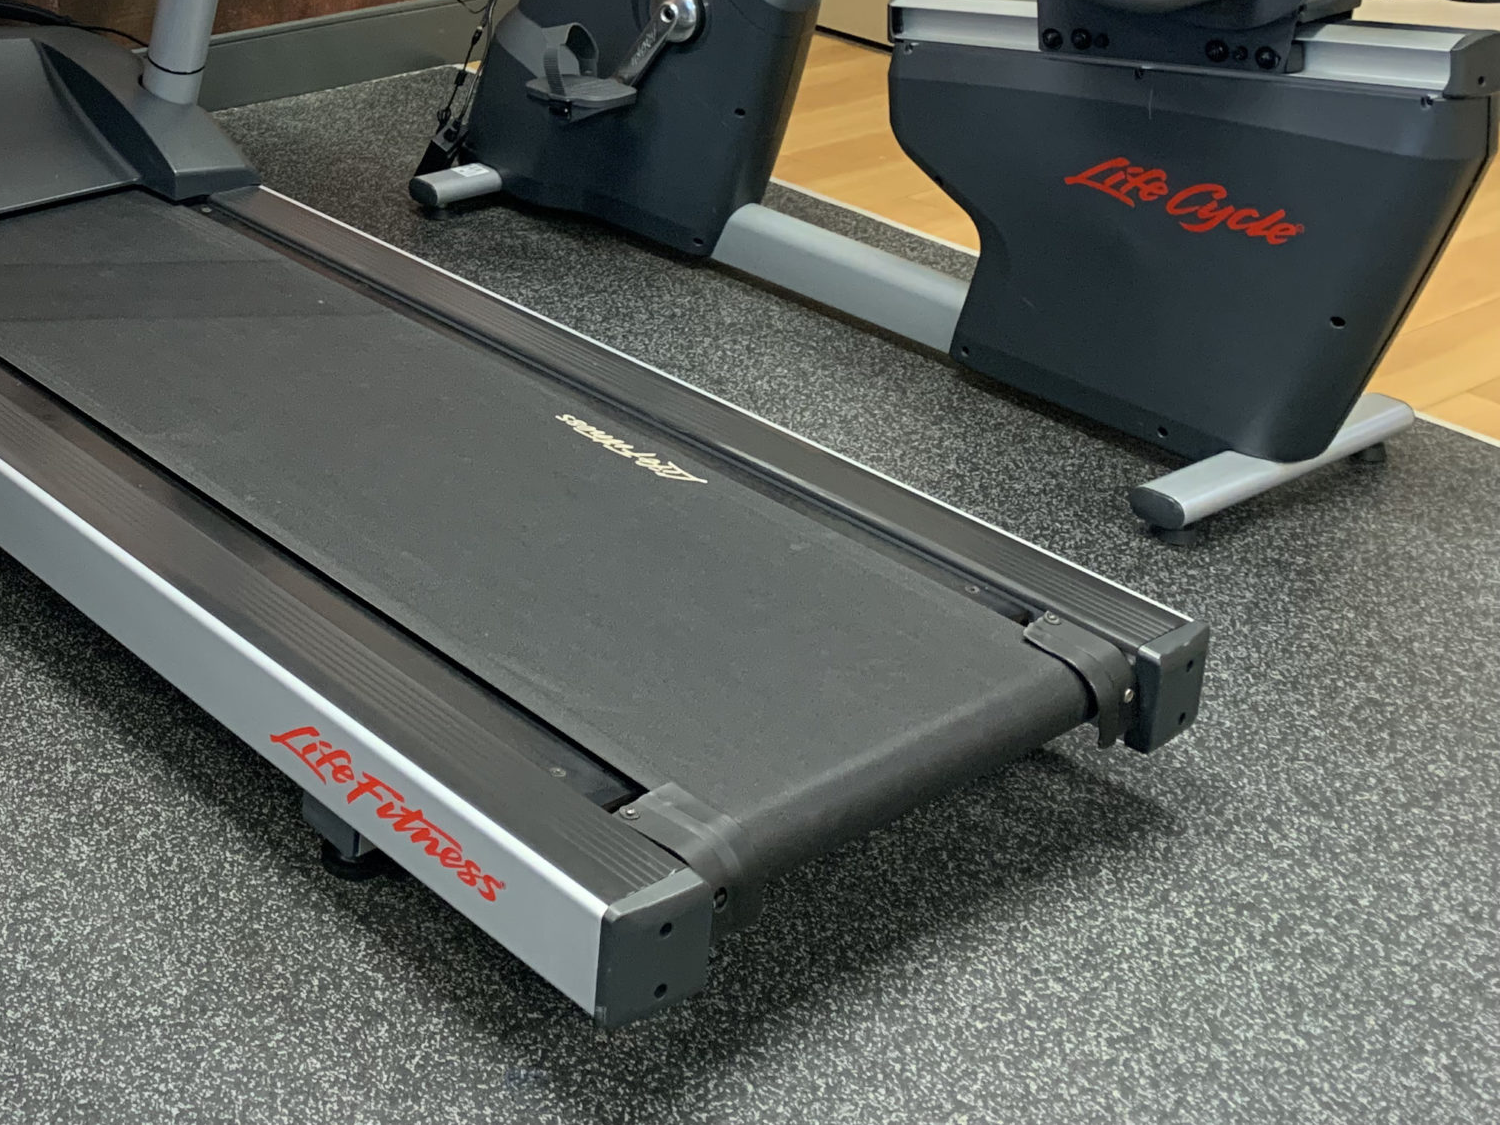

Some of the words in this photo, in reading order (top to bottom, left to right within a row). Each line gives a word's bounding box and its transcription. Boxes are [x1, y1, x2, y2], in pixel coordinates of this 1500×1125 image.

[1064, 156, 1169, 208] Life
[1166, 183, 1298, 245] Cycle
[269, 725, 356, 786] Life
[346, 771, 500, 902] Fitness
